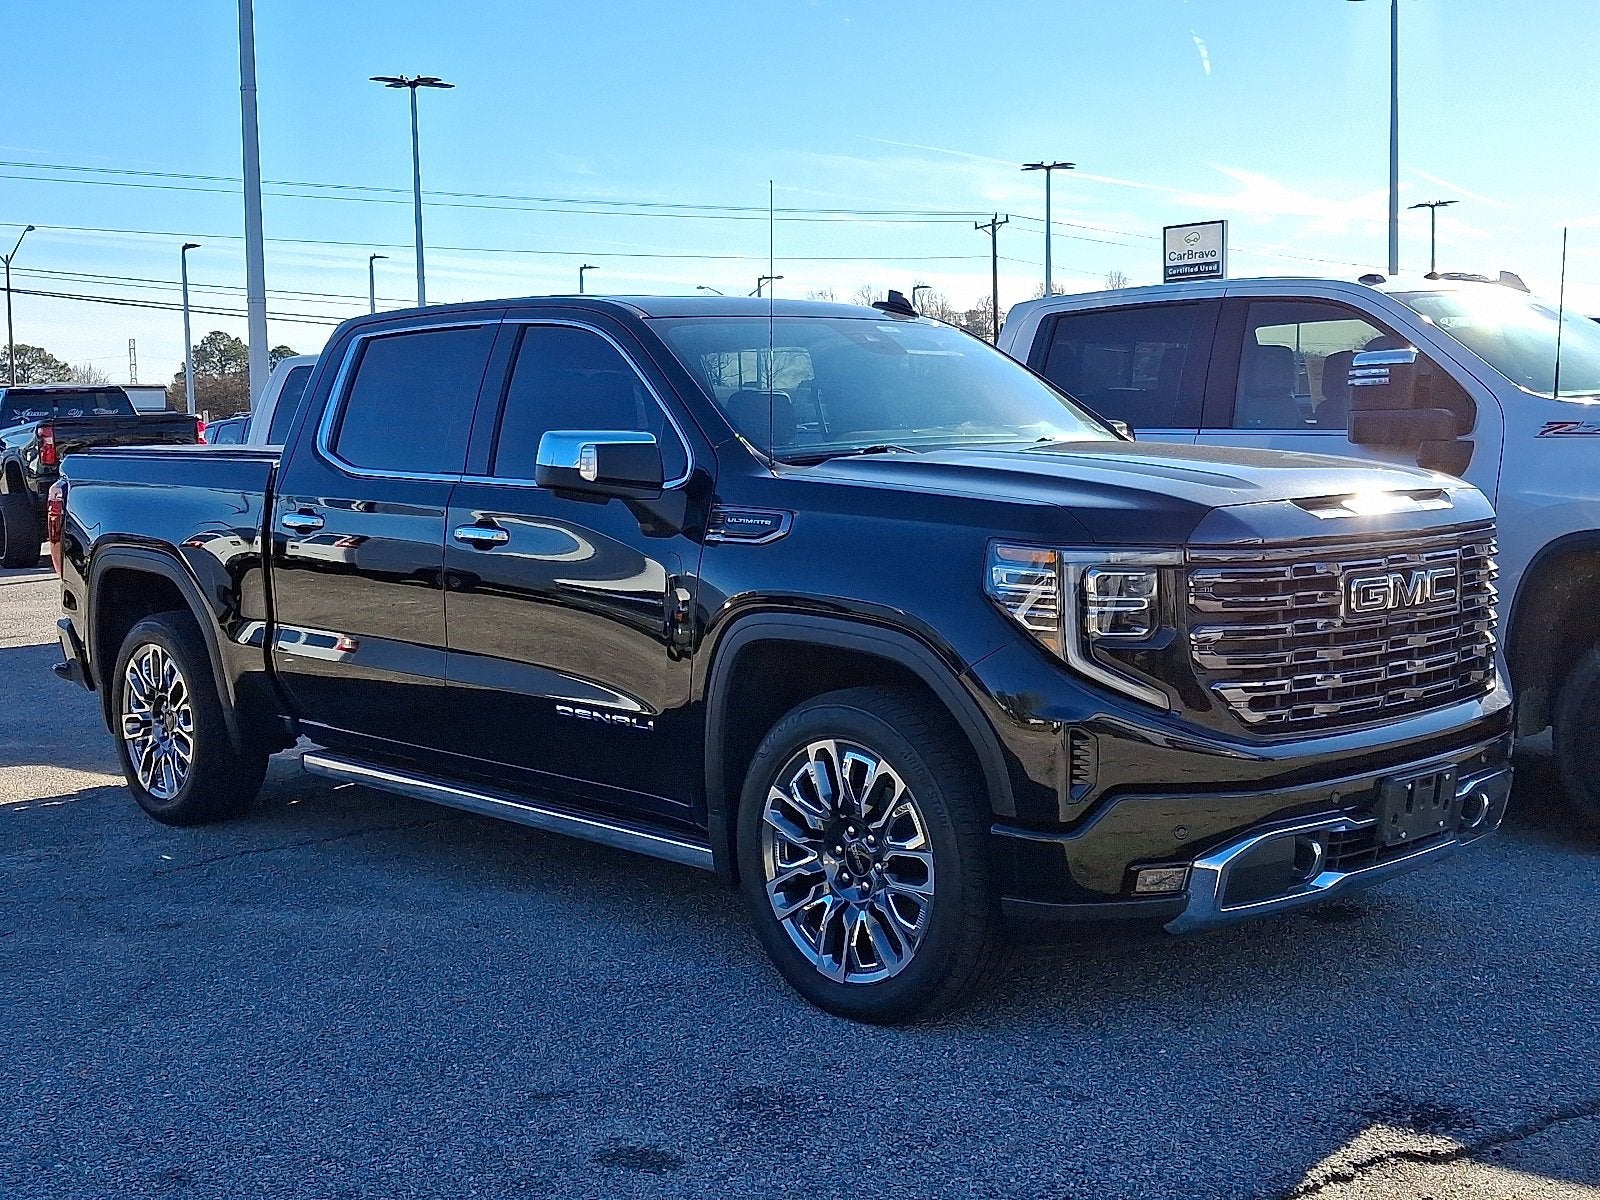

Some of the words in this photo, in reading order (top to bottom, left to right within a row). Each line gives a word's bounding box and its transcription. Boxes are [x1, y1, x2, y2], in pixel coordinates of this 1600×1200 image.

[1168, 249, 1217, 262] CarBravo
[1168, 266, 1199, 275] Certified
[1200, 263, 1217, 272] Used
[727, 517, 771, 526] ULTIMATE
[1351, 567, 1456, 613] GMC
[555, 704, 654, 731] DENALI
